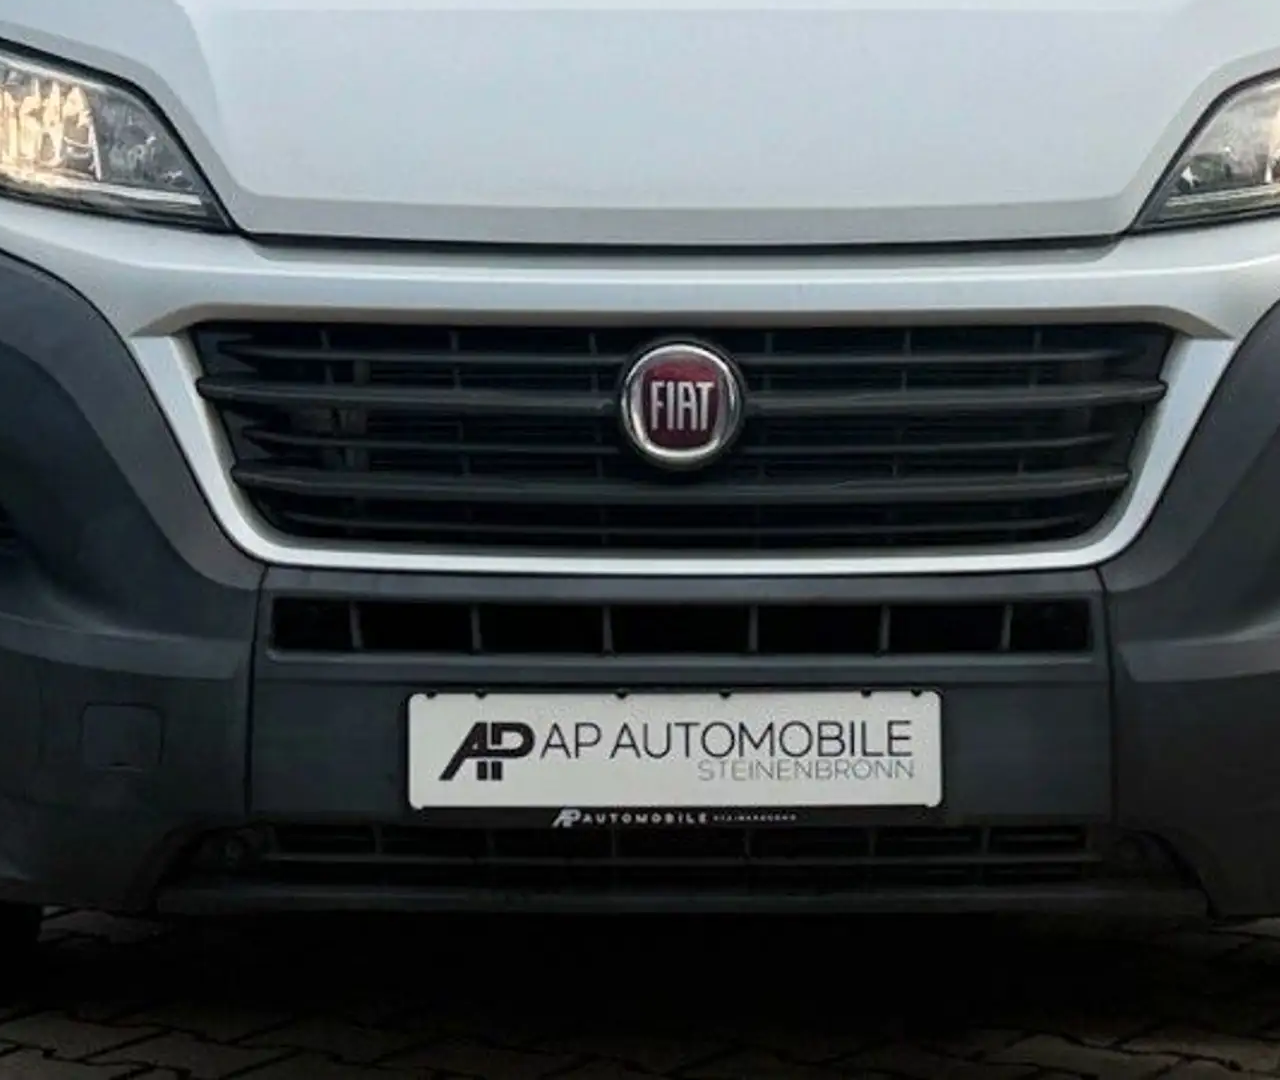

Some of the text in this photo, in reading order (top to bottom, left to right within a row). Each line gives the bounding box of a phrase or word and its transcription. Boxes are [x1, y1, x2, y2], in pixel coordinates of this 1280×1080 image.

[650, 379, 716, 432] FIAT
[540, 722, 603, 759] AP
[609, 720, 913, 758] AUTOMOBILE
[697, 758, 915, 782] STEINENBRONN
[582, 812, 708, 825] AUTOMOBILE
